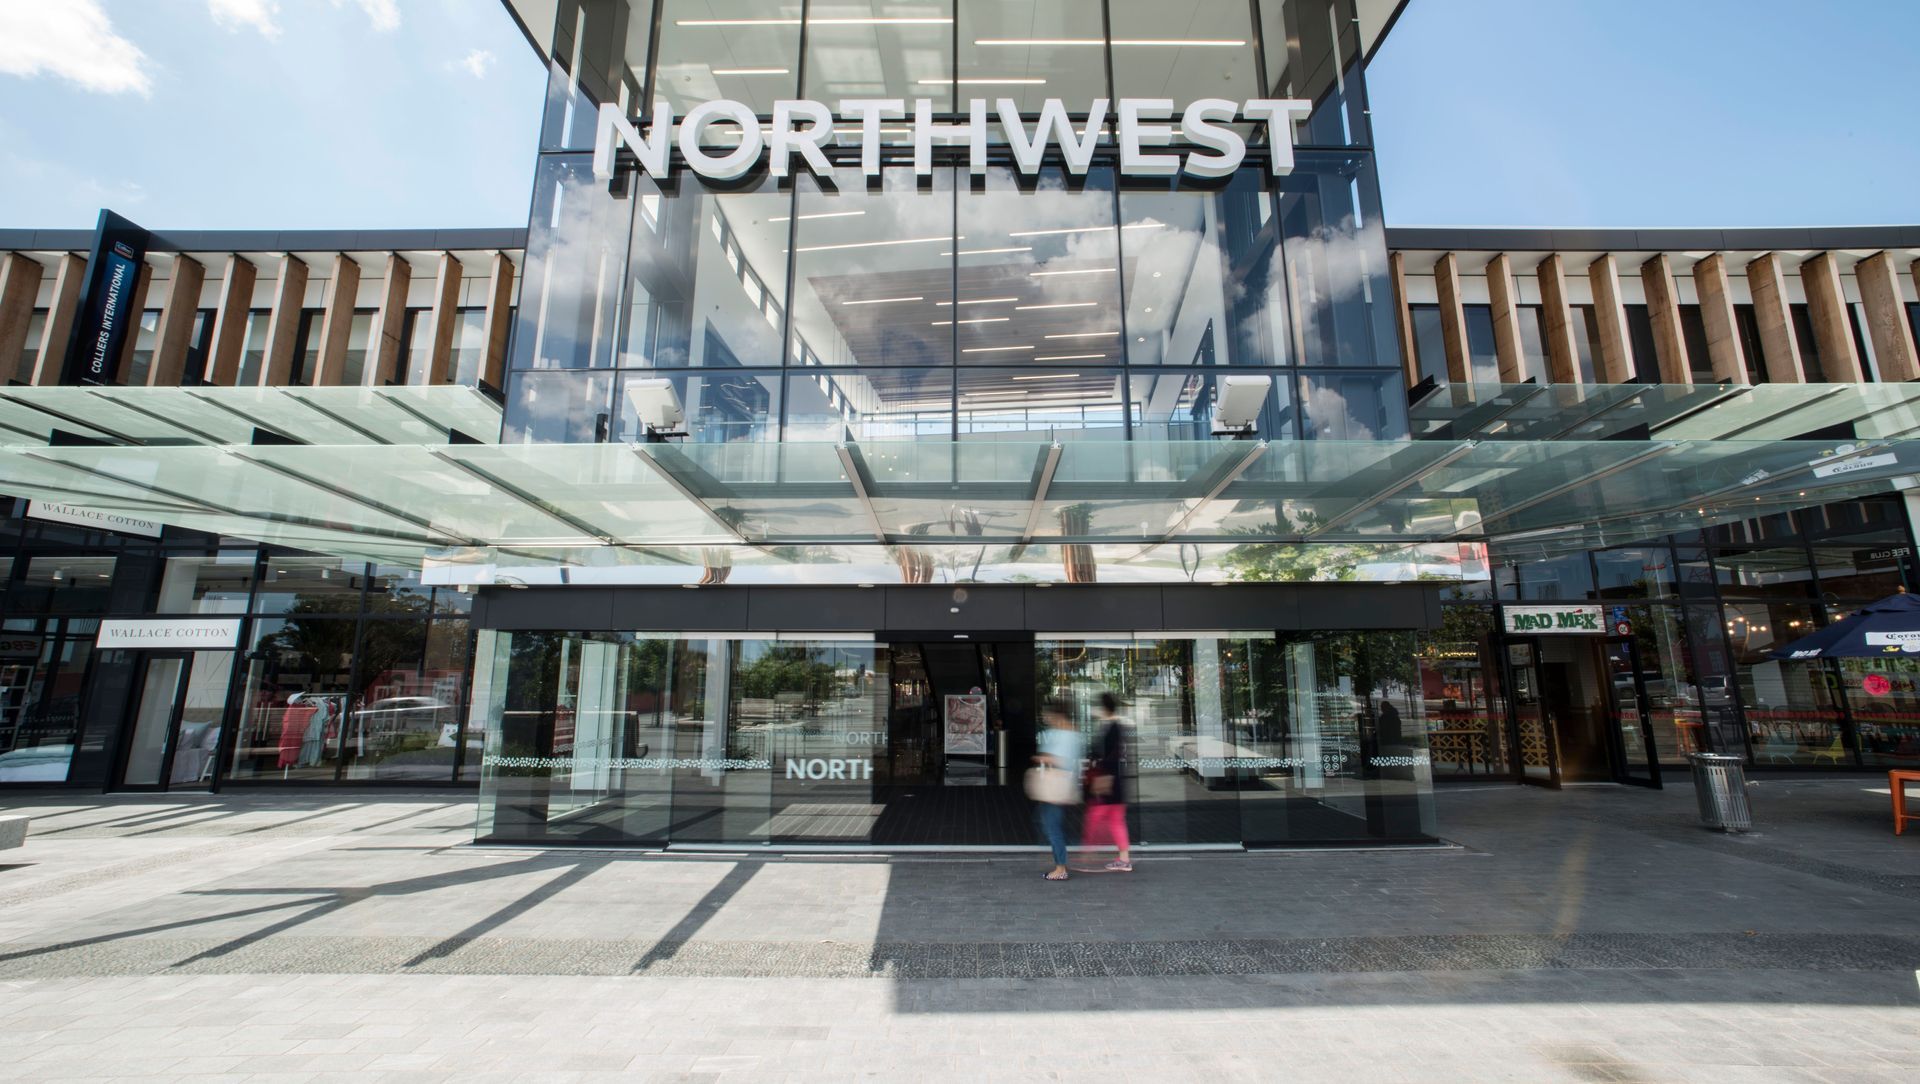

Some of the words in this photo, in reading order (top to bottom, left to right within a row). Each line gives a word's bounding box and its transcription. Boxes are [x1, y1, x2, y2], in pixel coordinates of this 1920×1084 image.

[592, 97, 1313, 179] NORTHWEST
[91, 330, 110, 374] COLLIERS
[103, 263, 126, 331] INTERNATIONAL
[42, 502, 104, 521] WALLACE
[107, 514, 155, 529] COTTON
[110, 627, 173, 638] WALLACE
[176, 627, 230, 637] COTTON
